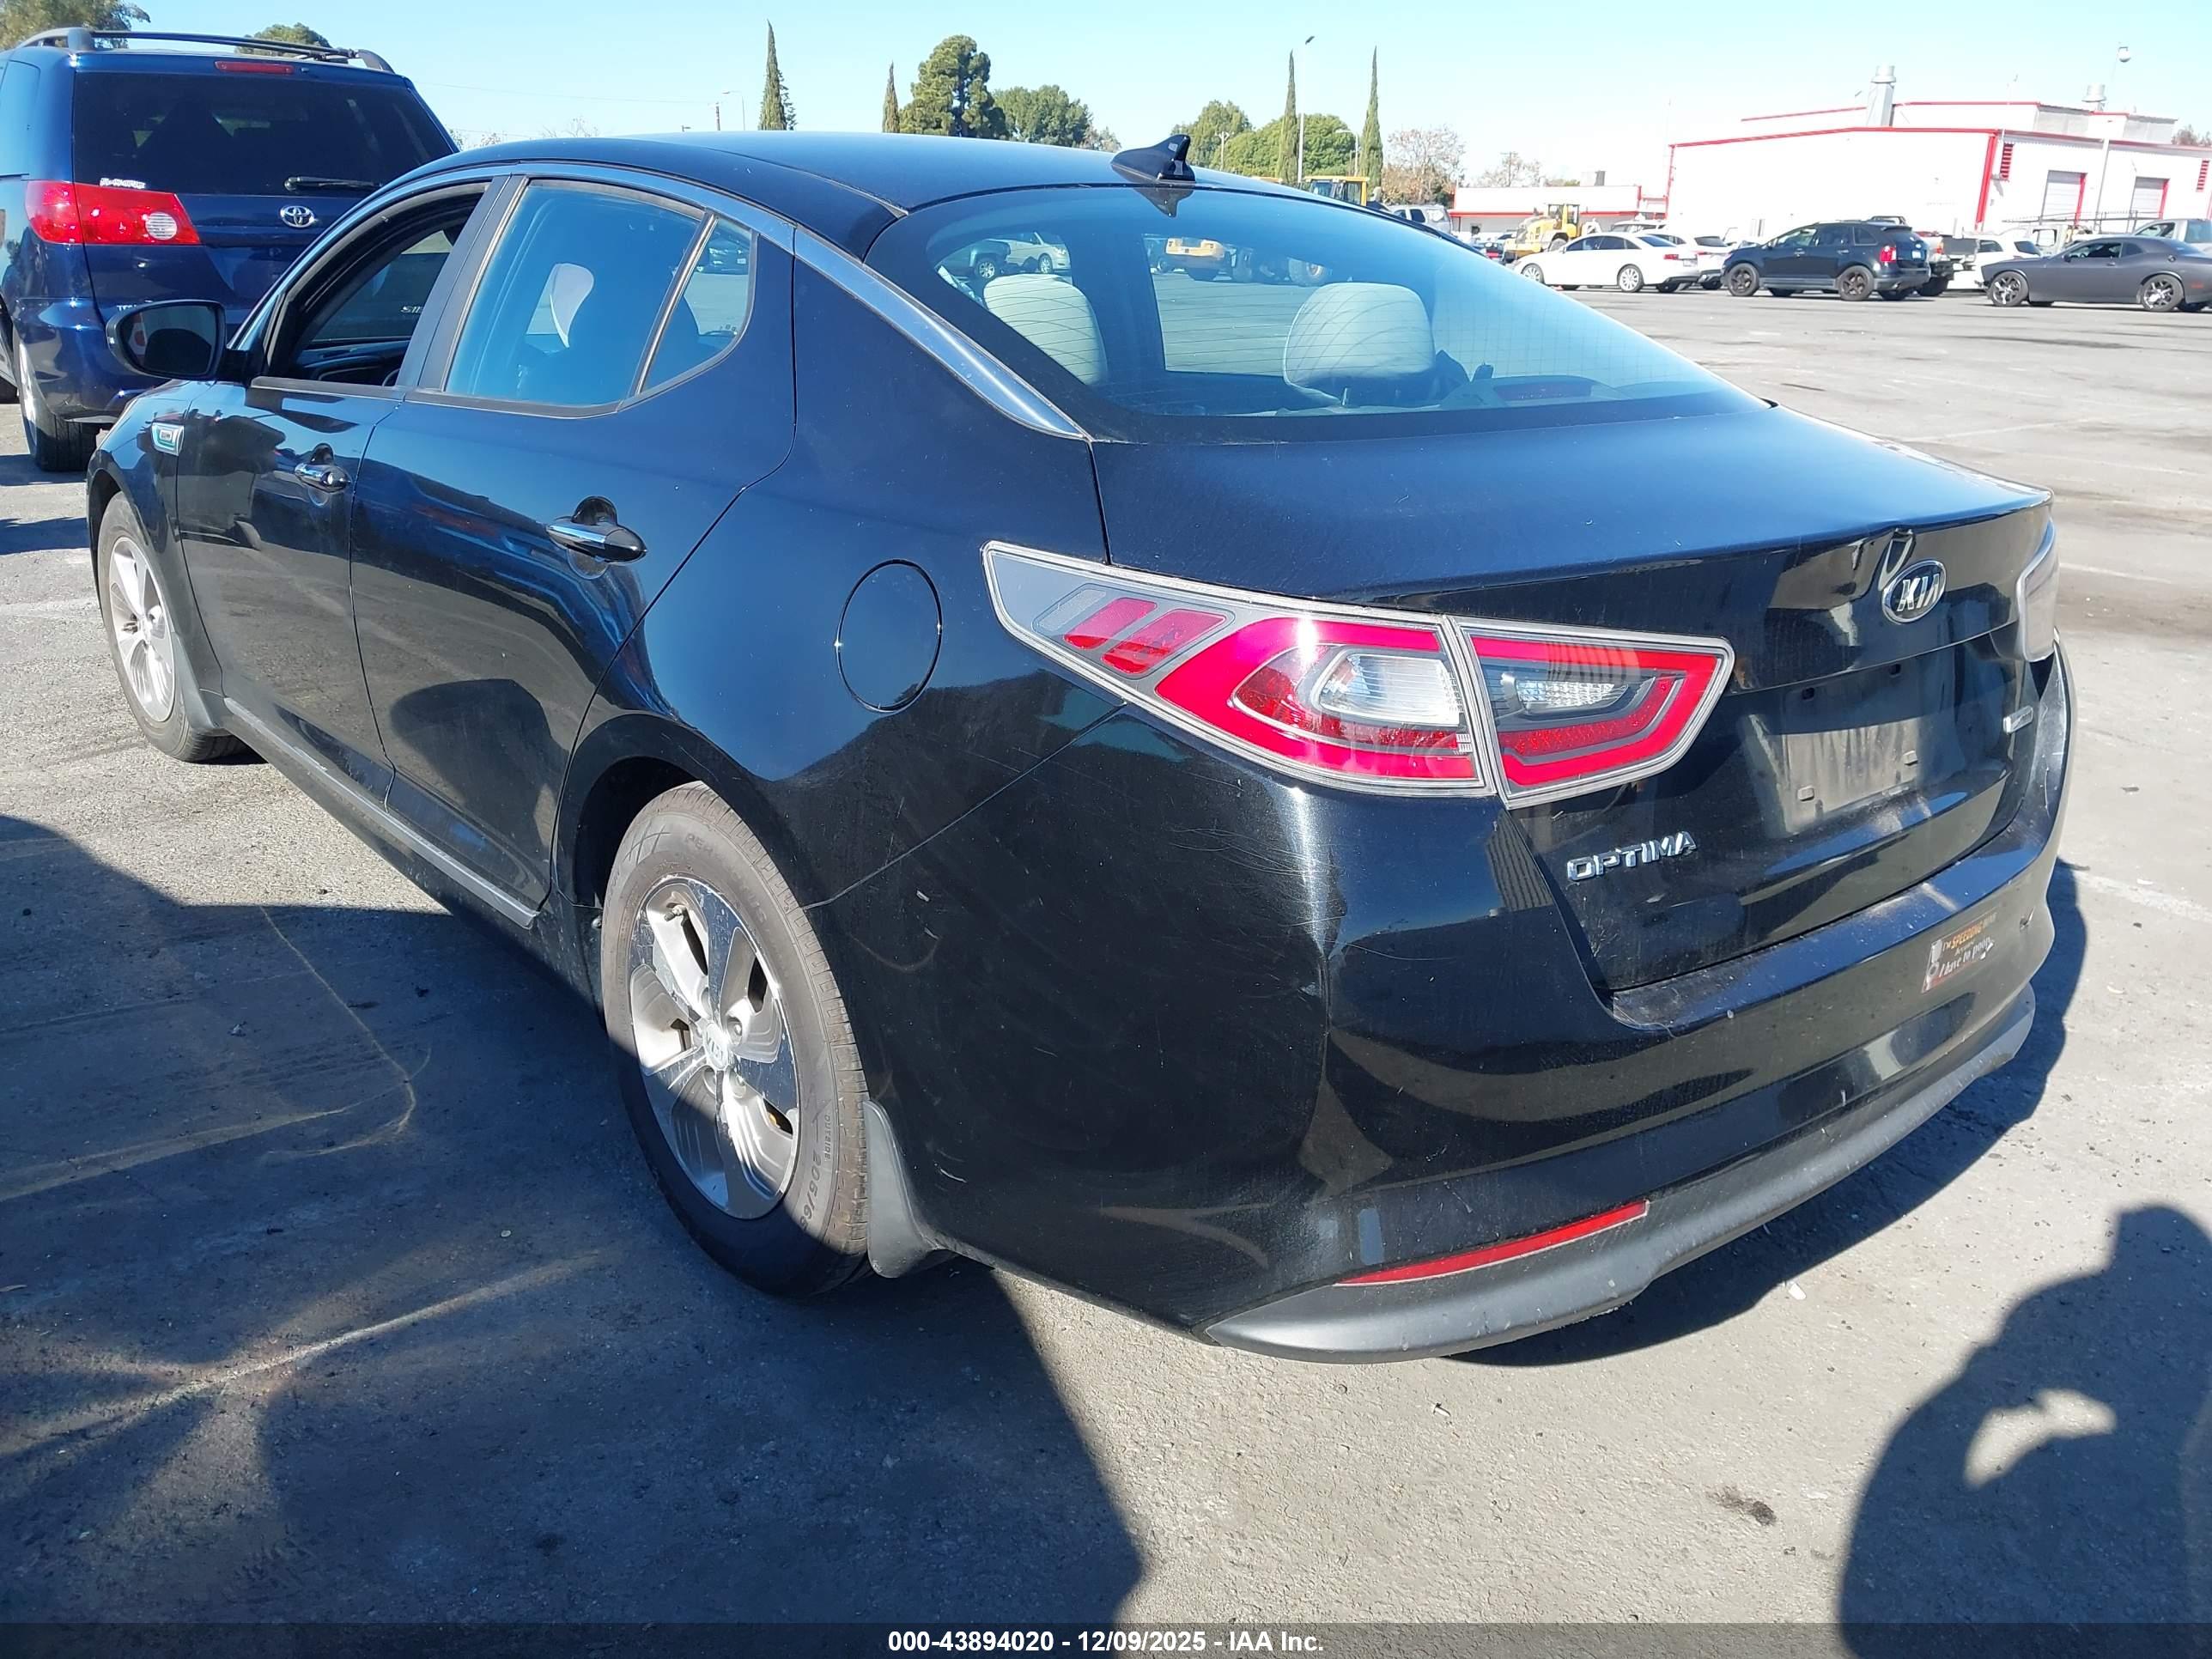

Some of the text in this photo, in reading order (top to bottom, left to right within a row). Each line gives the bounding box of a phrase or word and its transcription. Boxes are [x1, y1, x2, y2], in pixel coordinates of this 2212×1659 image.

[1896, 574, 1940, 611] KIA
[1566, 830, 1697, 881] OPTIMA
[799, 1150, 822, 1231] 205/65
